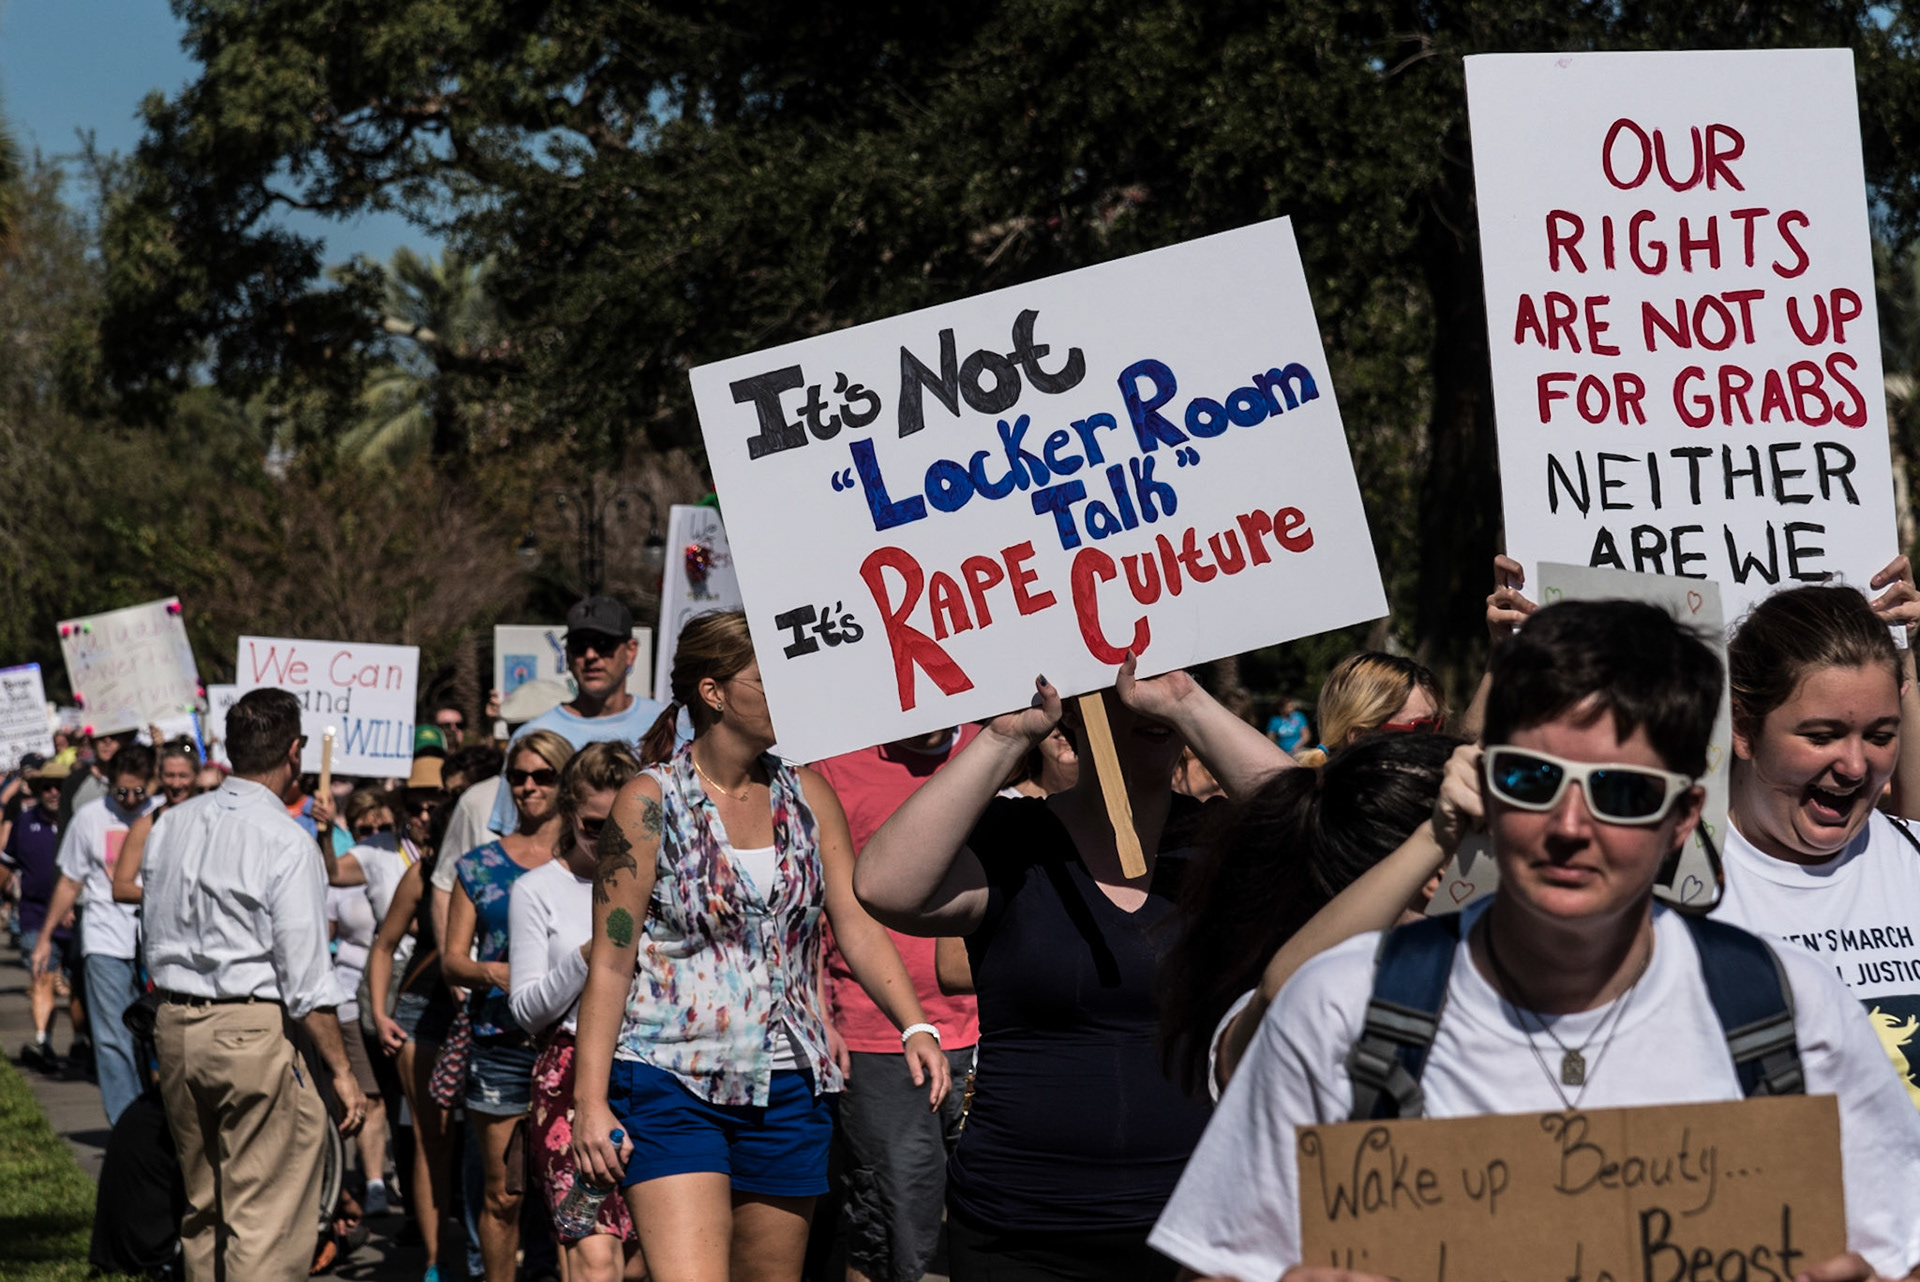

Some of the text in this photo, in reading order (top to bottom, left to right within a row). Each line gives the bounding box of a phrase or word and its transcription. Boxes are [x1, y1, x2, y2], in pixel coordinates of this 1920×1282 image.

[1602, 117, 1746, 193] OUR
[1546, 207, 1811, 279] RIGHTS
[1514, 287, 1864, 357] ARE NOT UP
[728, 308, 1086, 466] It's Not
[1116, 358, 1321, 453] Room
[1536, 352, 1868, 429] FOR GRABS
[1547, 441, 1862, 520] NEITHER
[1589, 520, 1833, 585] ARE WE
[773, 505, 1316, 713] It's RAPE Culture
[249, 641, 403, 690] We Can
[296, 687, 351, 713] and
[1840, 926, 1915, 952] MARCH
[1300, 1126, 1444, 1222] Wake
[1462, 1158, 1510, 1217] up
[1638, 1203, 1804, 1282] Beast
